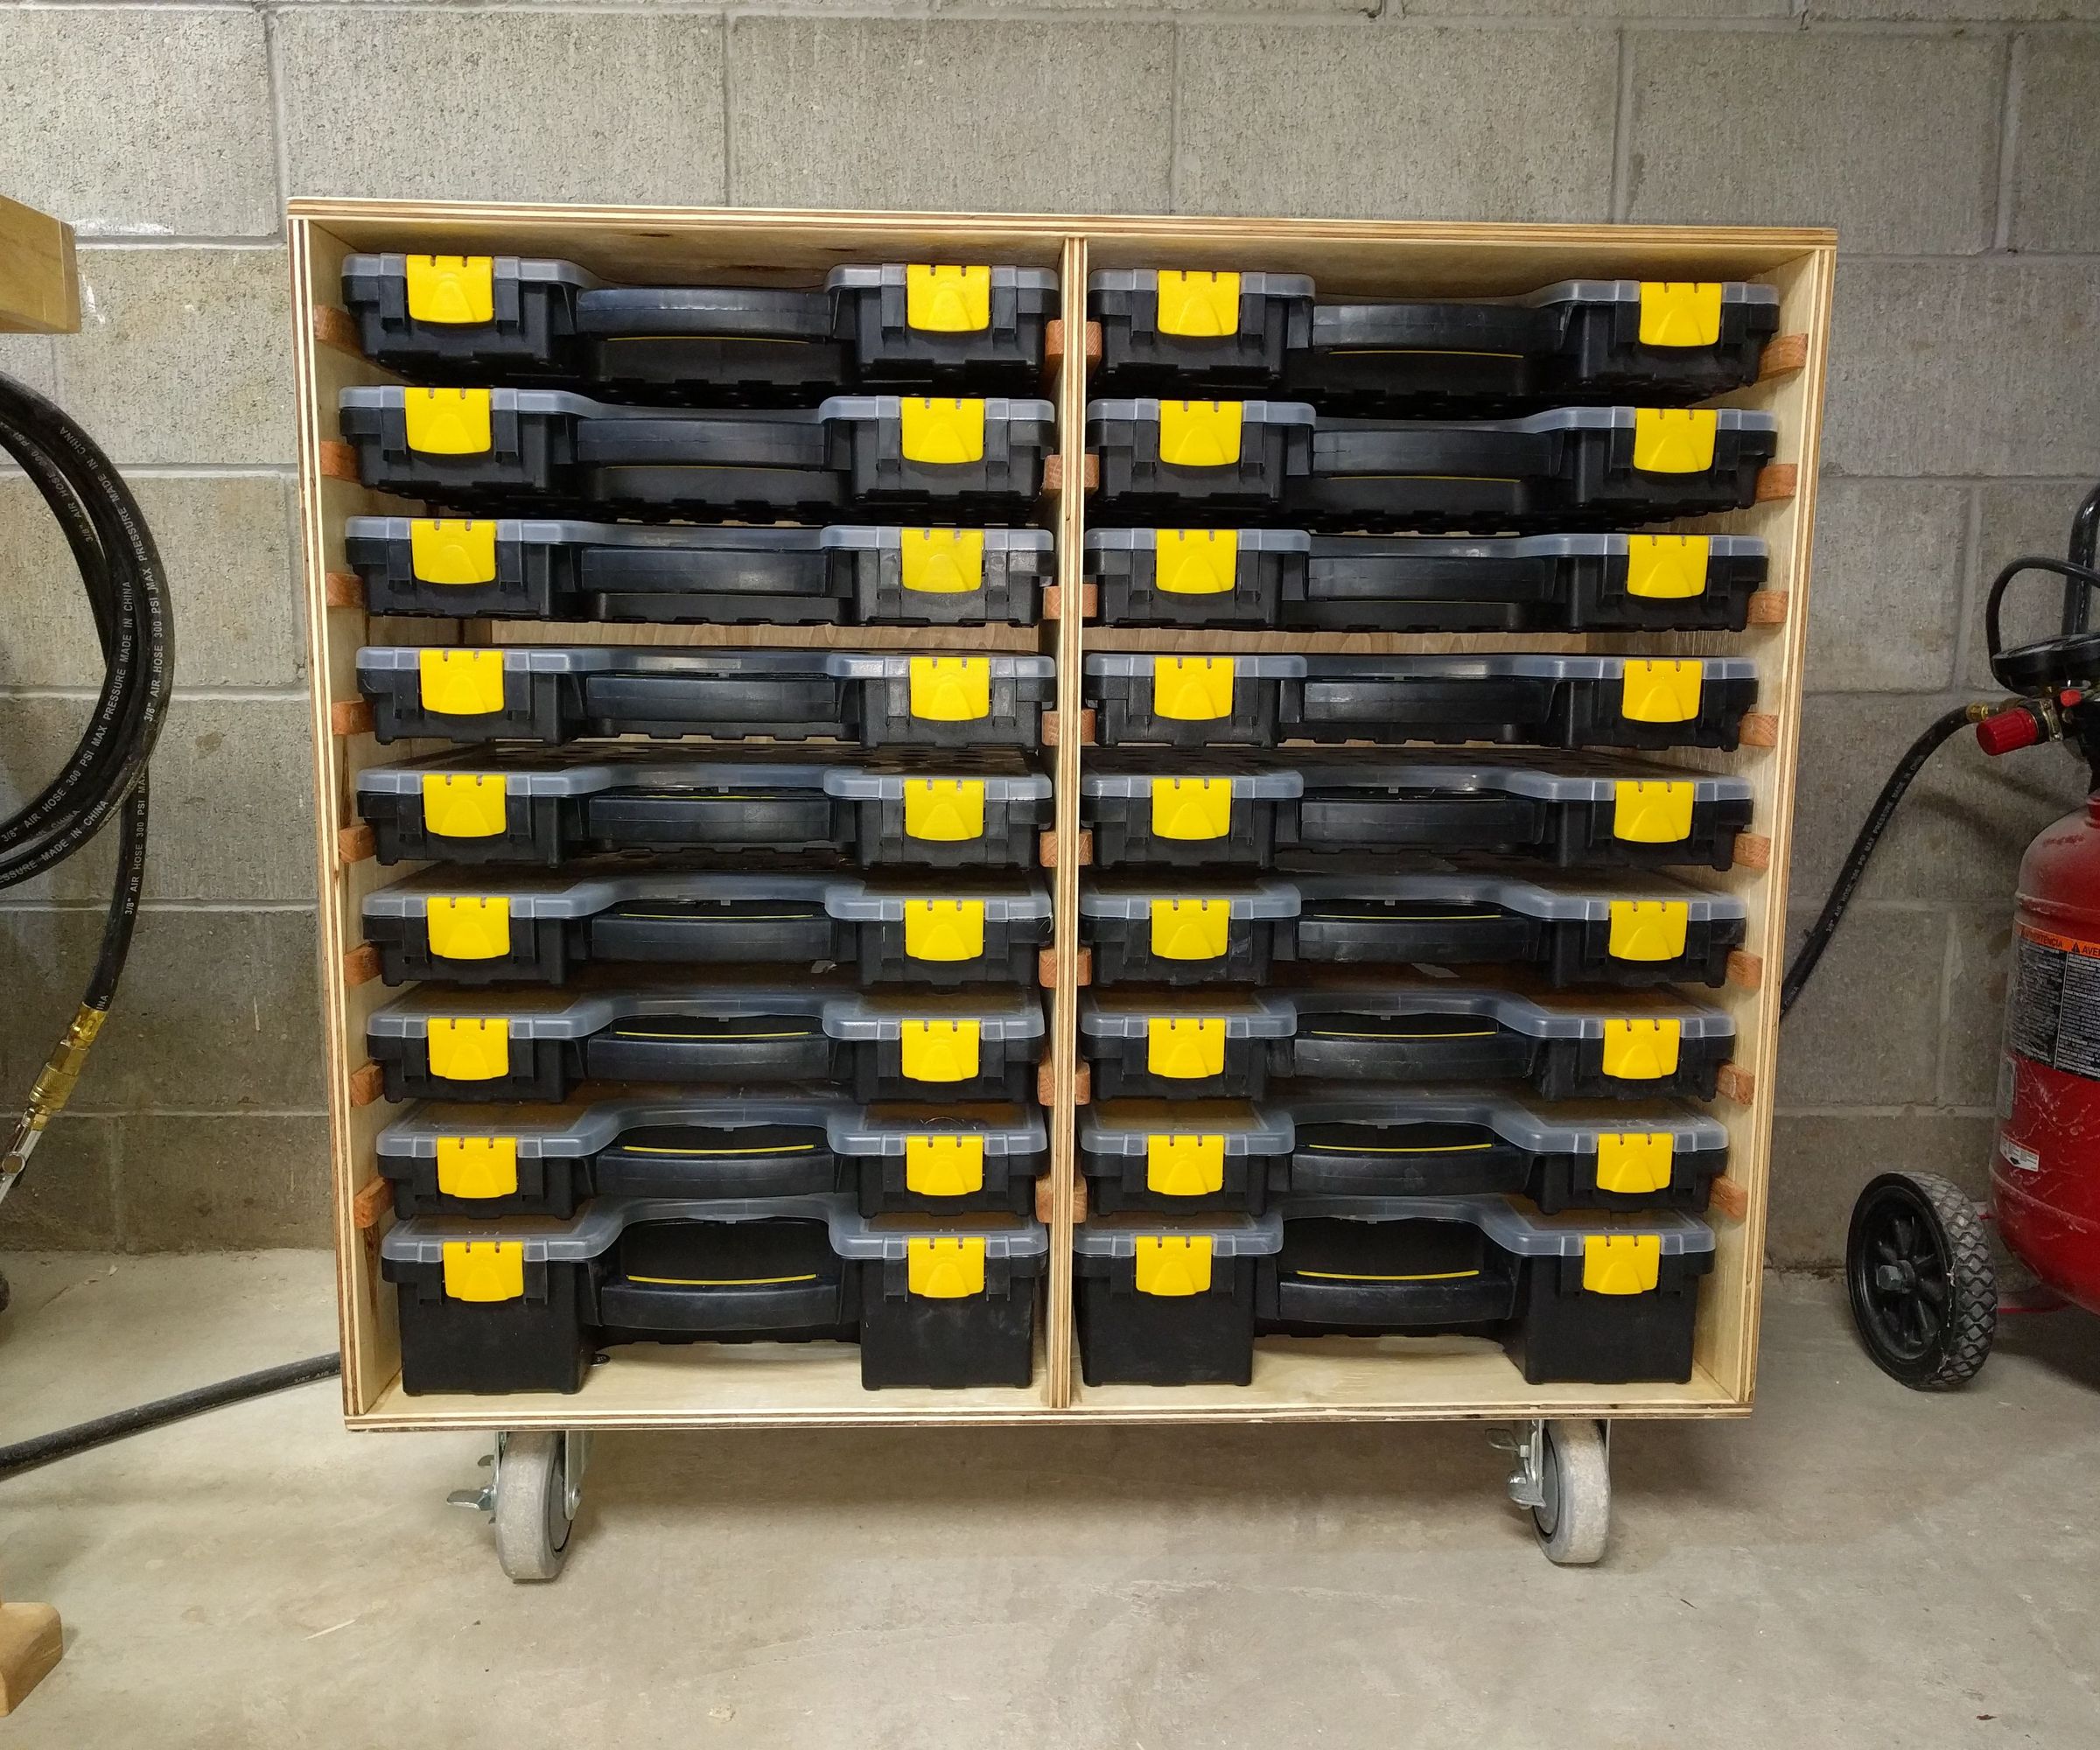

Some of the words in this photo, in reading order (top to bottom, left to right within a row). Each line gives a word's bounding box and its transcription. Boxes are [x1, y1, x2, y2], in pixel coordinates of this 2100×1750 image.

[60, 426, 86, 455] CHINA
[87, 458, 99, 470] IN
[98, 473, 121, 503] MADE
[68, 501, 81, 518] AIR
[118, 507, 148, 562] PRESSURE
[144, 567, 158, 591] MAX
[122, 581, 133, 612] CHINA
[150, 597, 162, 614] PSI
[123, 618, 133, 628] IN
[153, 620, 163, 638] 300
[119, 634, 131, 662] MADE
[153, 645, 164, 673] HOSE
[103, 668, 126, 721] PRESSURE
[150, 679, 162, 697] AIR
[91, 724, 108, 746] MAX
[80, 750, 94, 766] PSI
[66, 770, 81, 786] 300
[41, 788, 66, 812] HOSE
[24, 813, 42, 829] AIR
[40, 838, 69, 861] MADE
[70, 827, 83, 839] IN
[83, 799, 109, 827] CHINA
[136, 822, 144, 837] 300
[133, 844, 143, 870] HOSE
[130, 876, 140, 892] AIR
[2082, 946, 2100, 956] AVE
